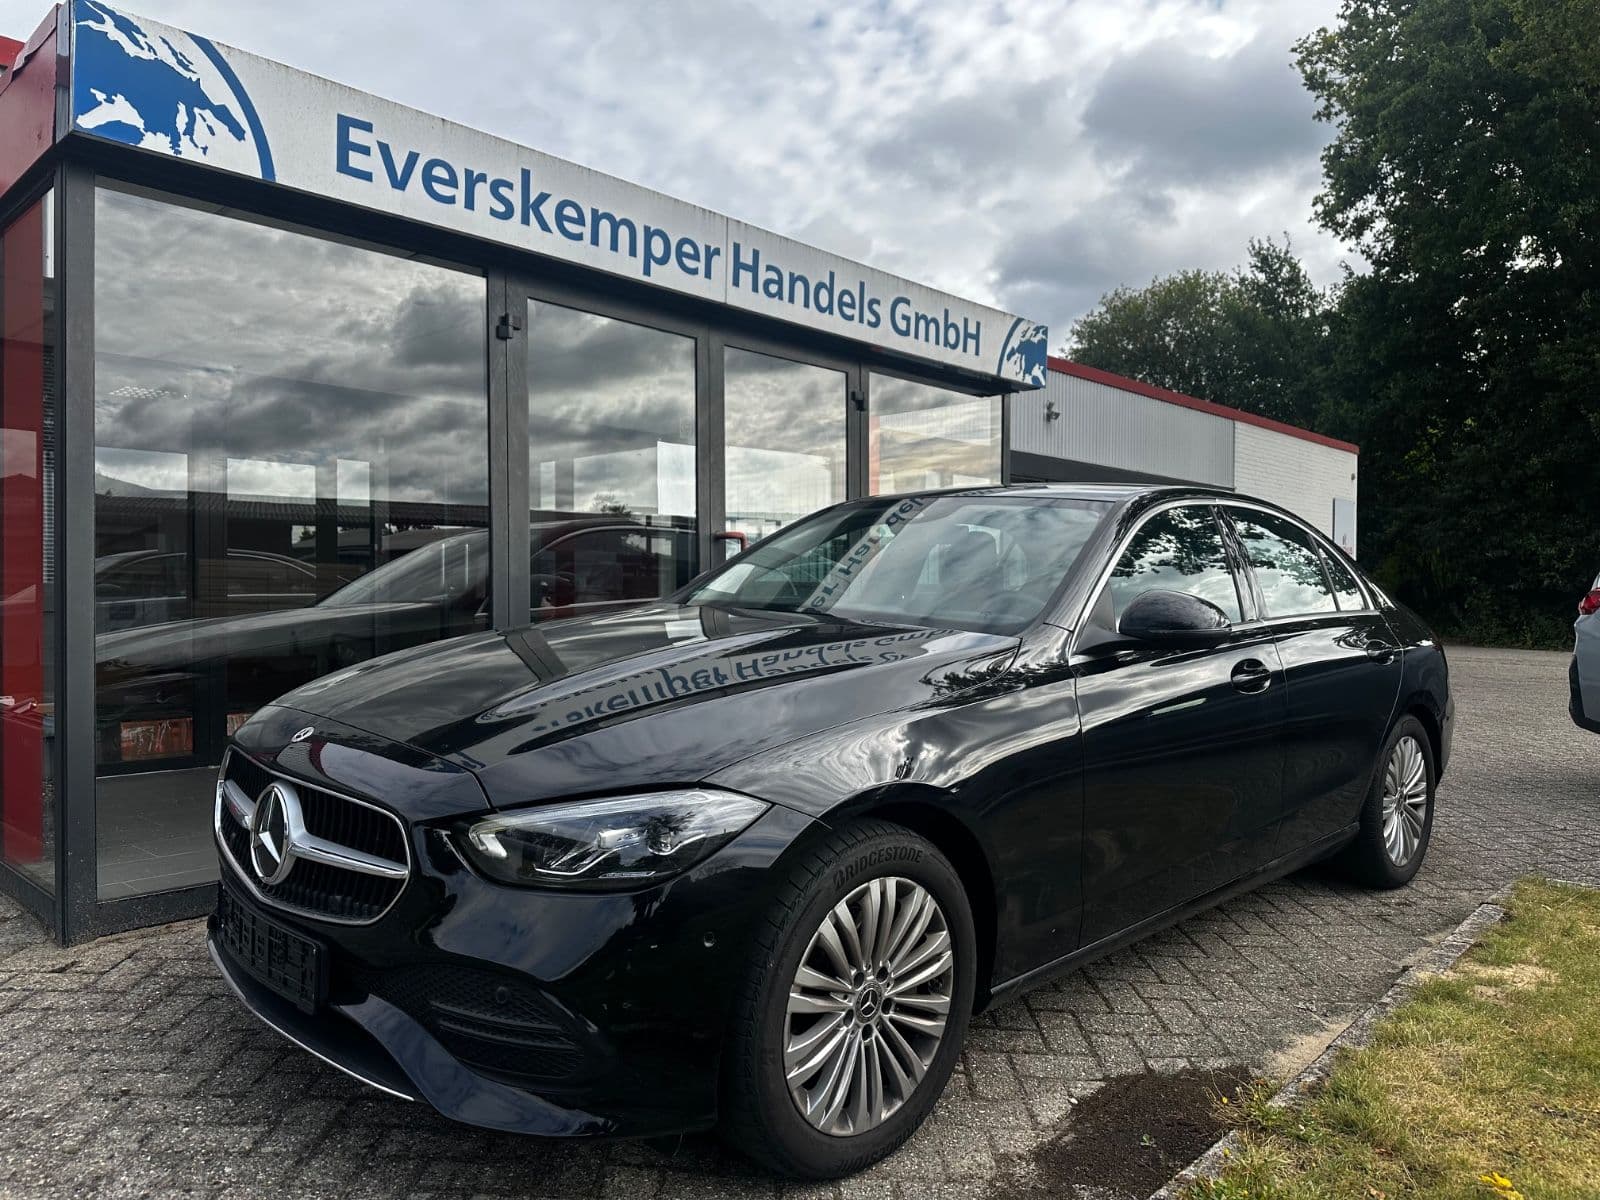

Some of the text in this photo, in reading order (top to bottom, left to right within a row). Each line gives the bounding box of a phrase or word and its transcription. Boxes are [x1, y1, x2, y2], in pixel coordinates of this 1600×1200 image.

[336, 113, 981, 356] Everskemper Handels GmbH
[833, 846, 923, 888] BRIDGESTONE
